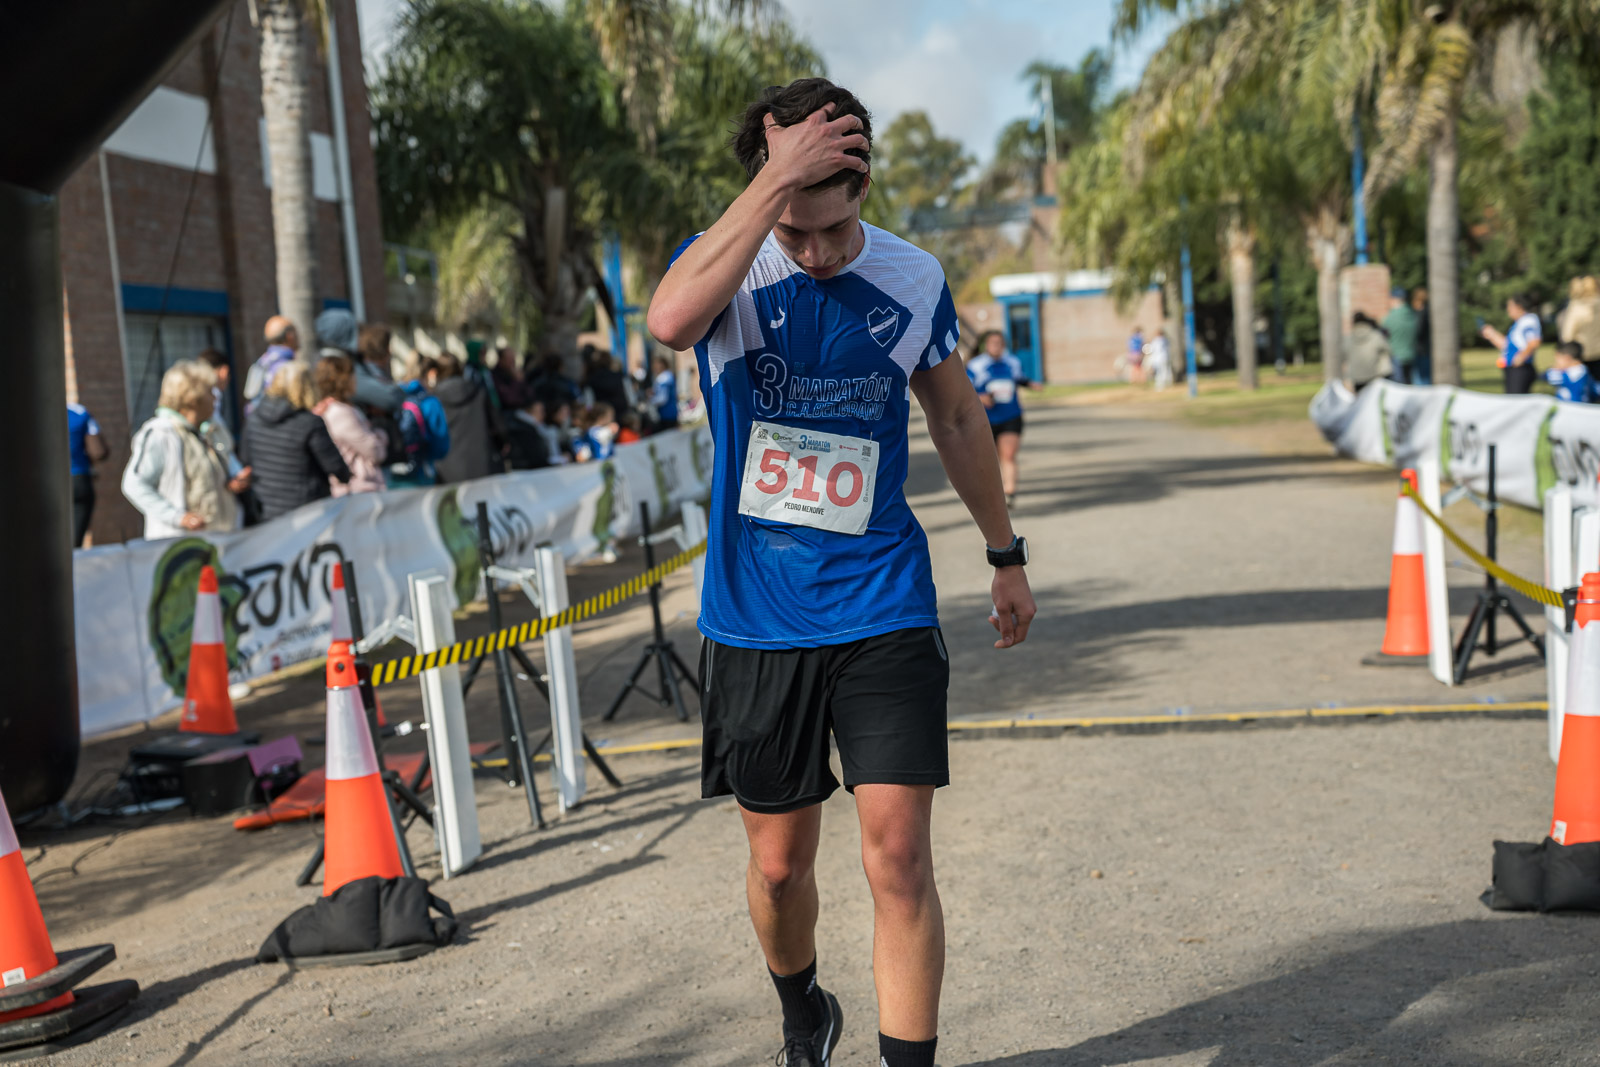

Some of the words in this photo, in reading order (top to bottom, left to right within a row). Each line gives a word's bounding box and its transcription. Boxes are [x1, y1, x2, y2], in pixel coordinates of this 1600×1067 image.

[753, 353, 787, 418] 3
[788, 372, 892, 402] MARATÓN
[798, 434, 808, 450] 3
[754, 448, 864, 508] 510
[784, 501, 802, 512] PEDRO
